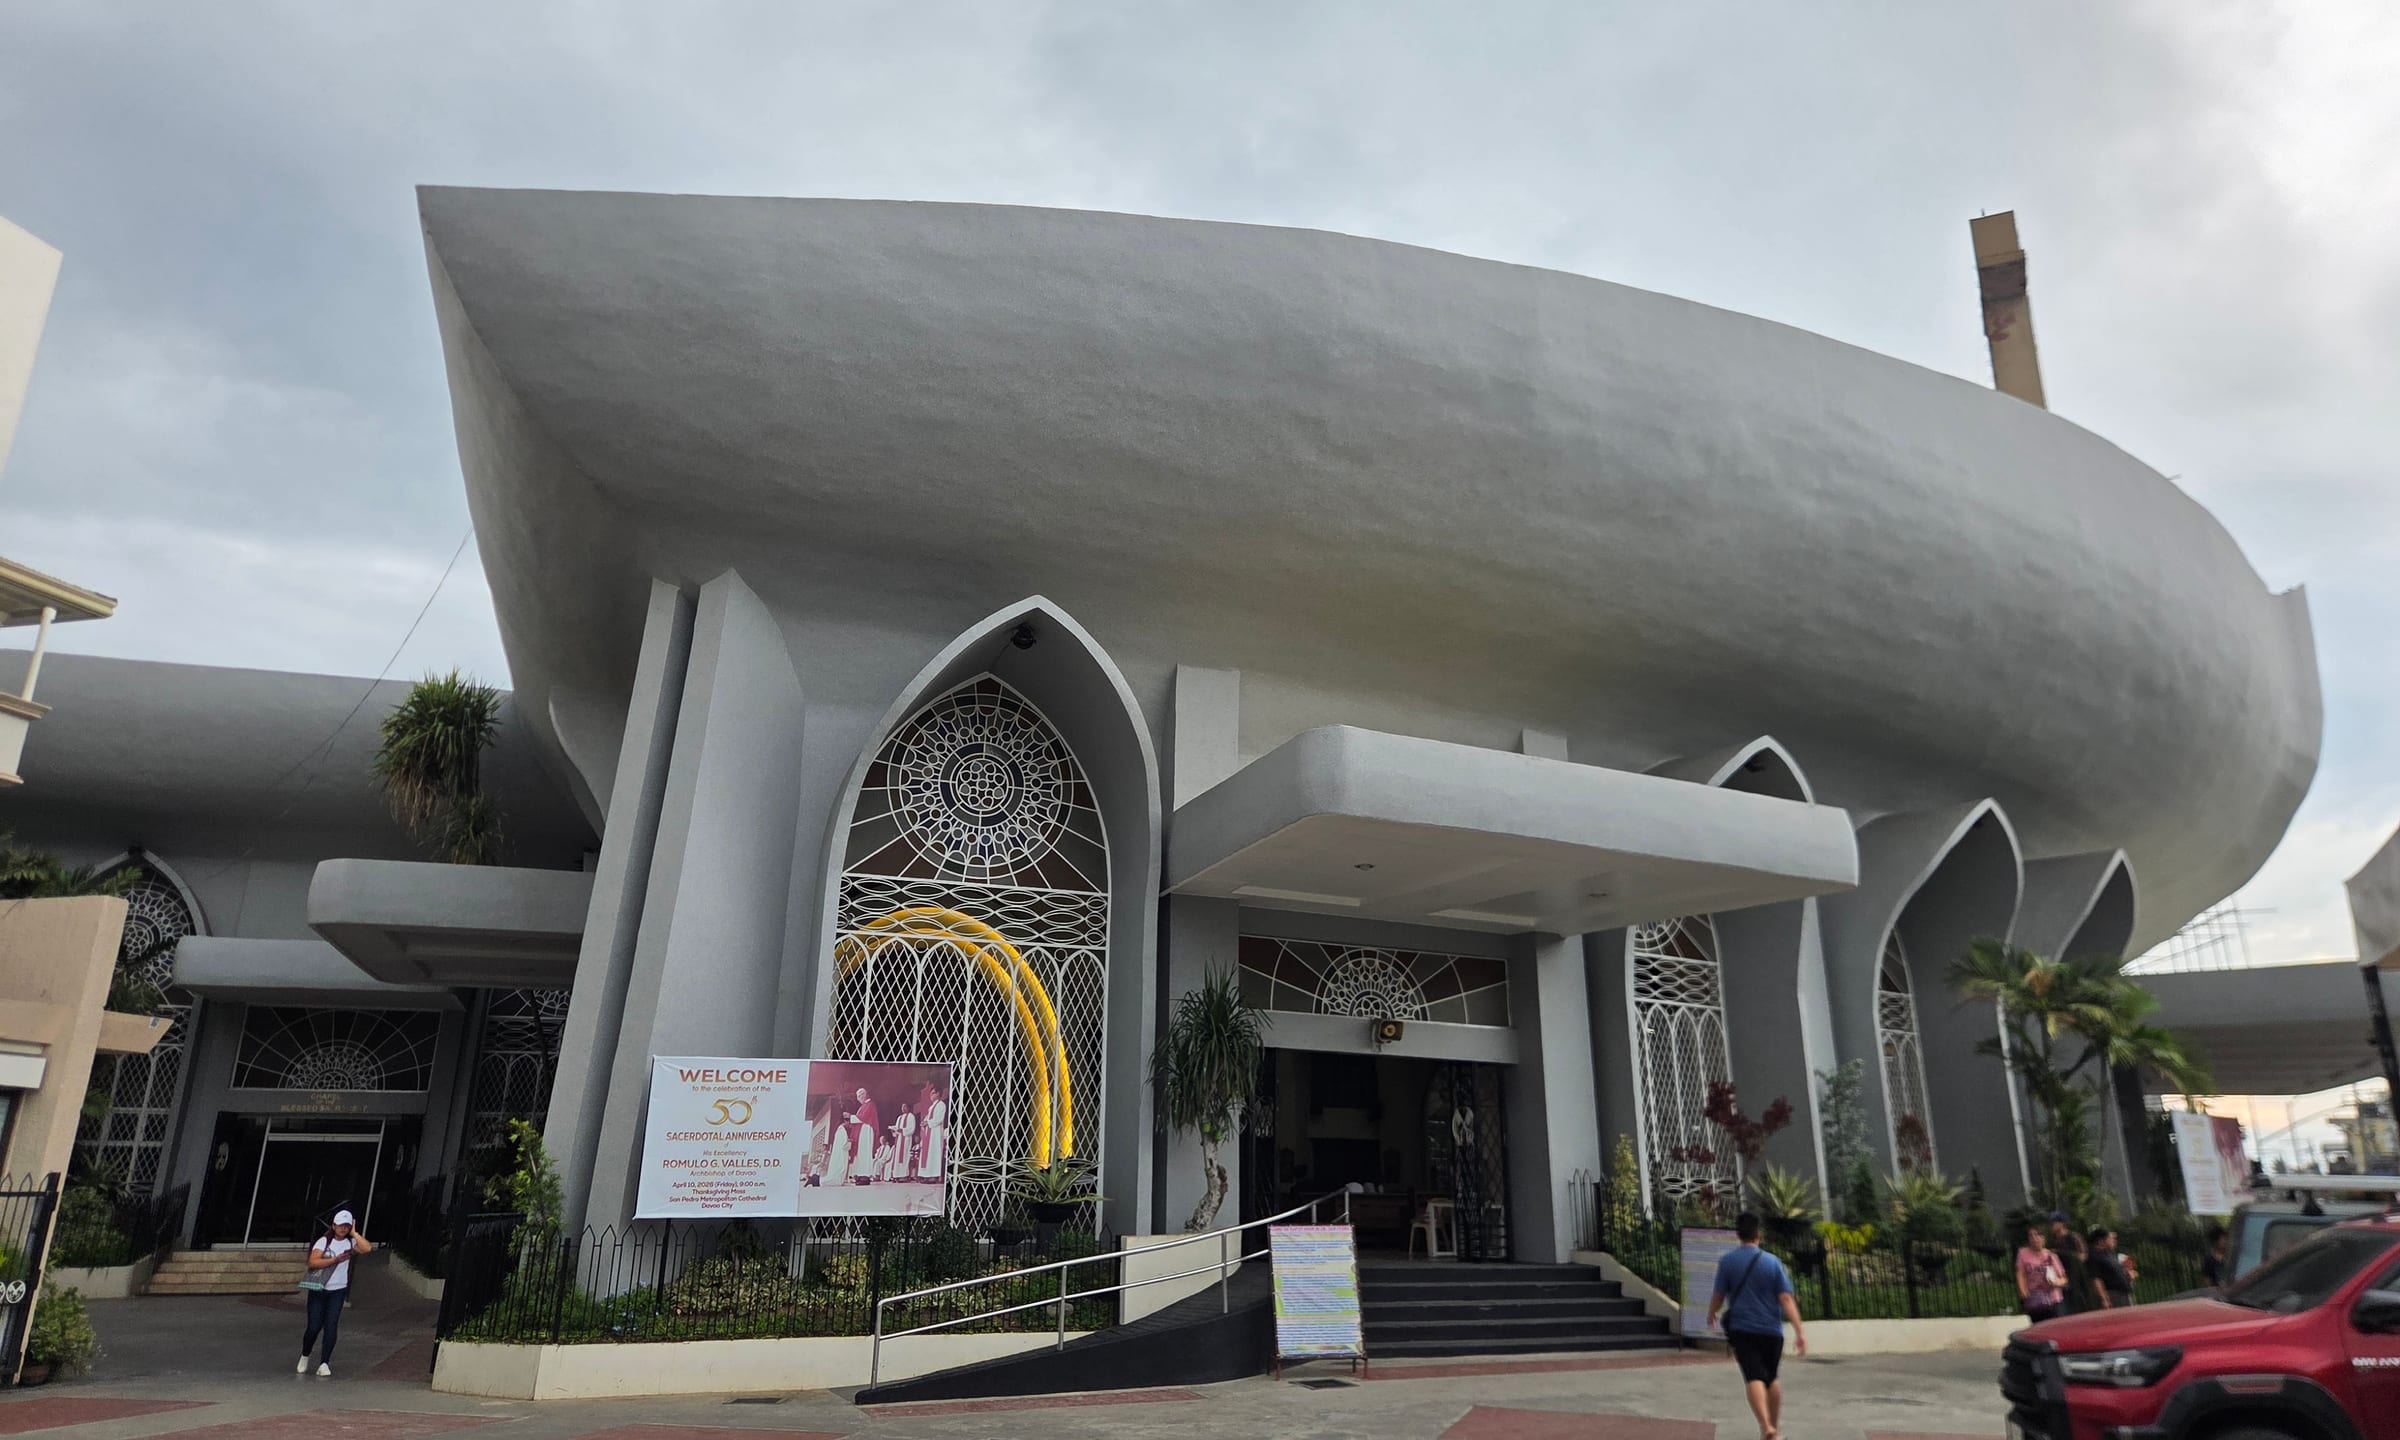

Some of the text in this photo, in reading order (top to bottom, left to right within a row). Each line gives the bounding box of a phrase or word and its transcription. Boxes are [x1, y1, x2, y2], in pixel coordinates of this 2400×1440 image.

[679, 1069, 788, 1083] WELCOME
[752, 1085, 760, 1093] of
[666, 1131, 787, 1141] SACERDOTAL ANNIVERSARY
[663, 1158, 782, 1169] ROMULO G. VALLES, D.D.
[692, 1188, 730, 1196] Thanksgiving
